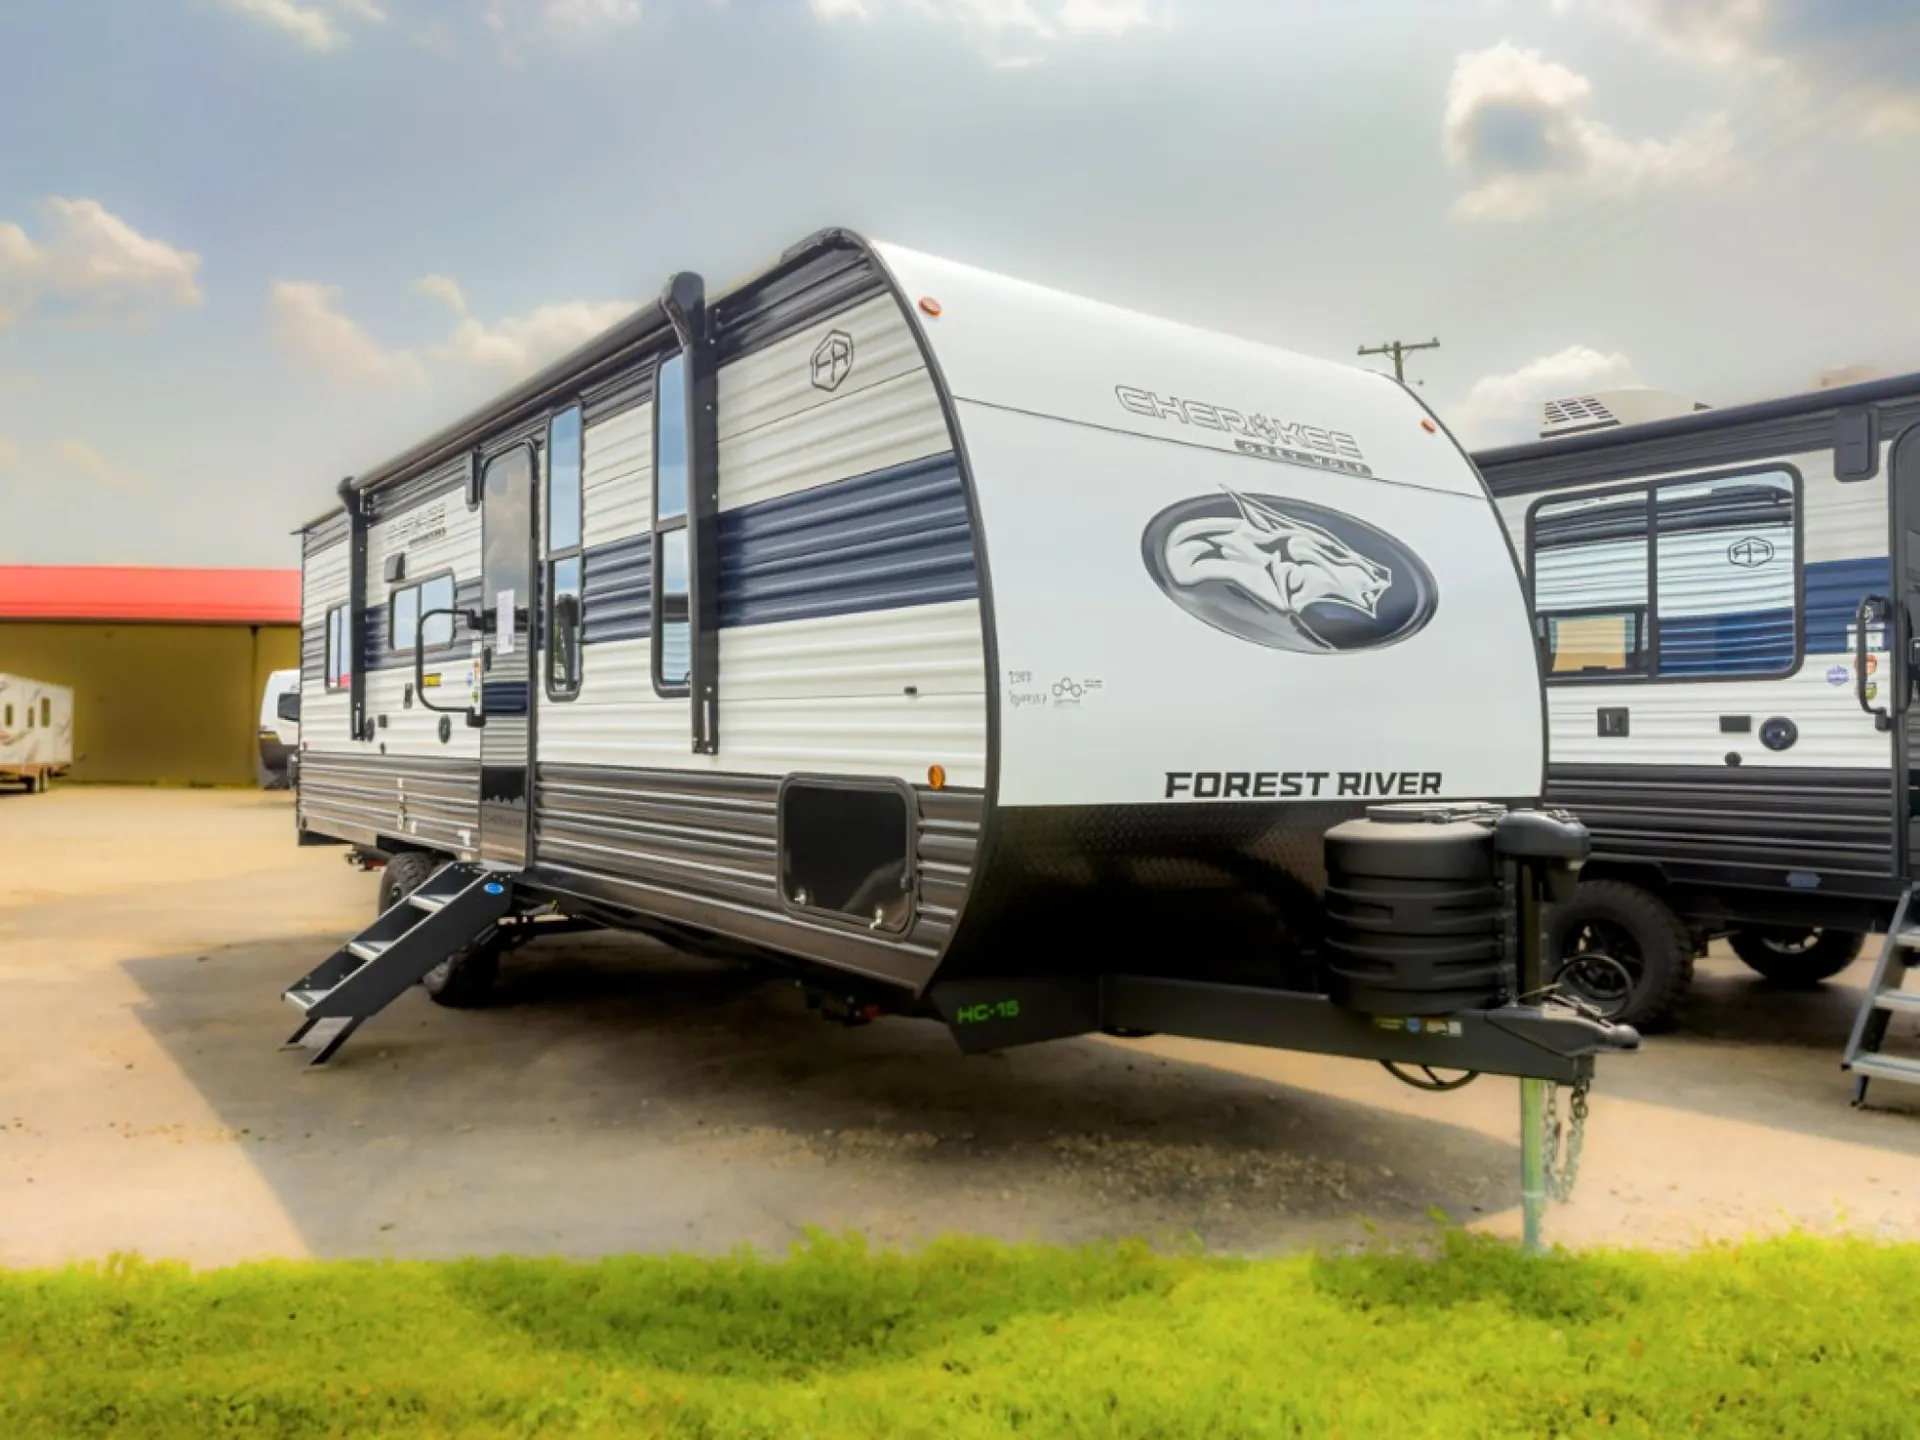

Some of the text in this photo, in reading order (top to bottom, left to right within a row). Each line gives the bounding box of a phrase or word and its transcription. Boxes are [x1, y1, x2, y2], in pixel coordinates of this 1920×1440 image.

[1115, 384, 1364, 460] CHEROKEE
[1165, 772, 1443, 797] FOREST RIVER
